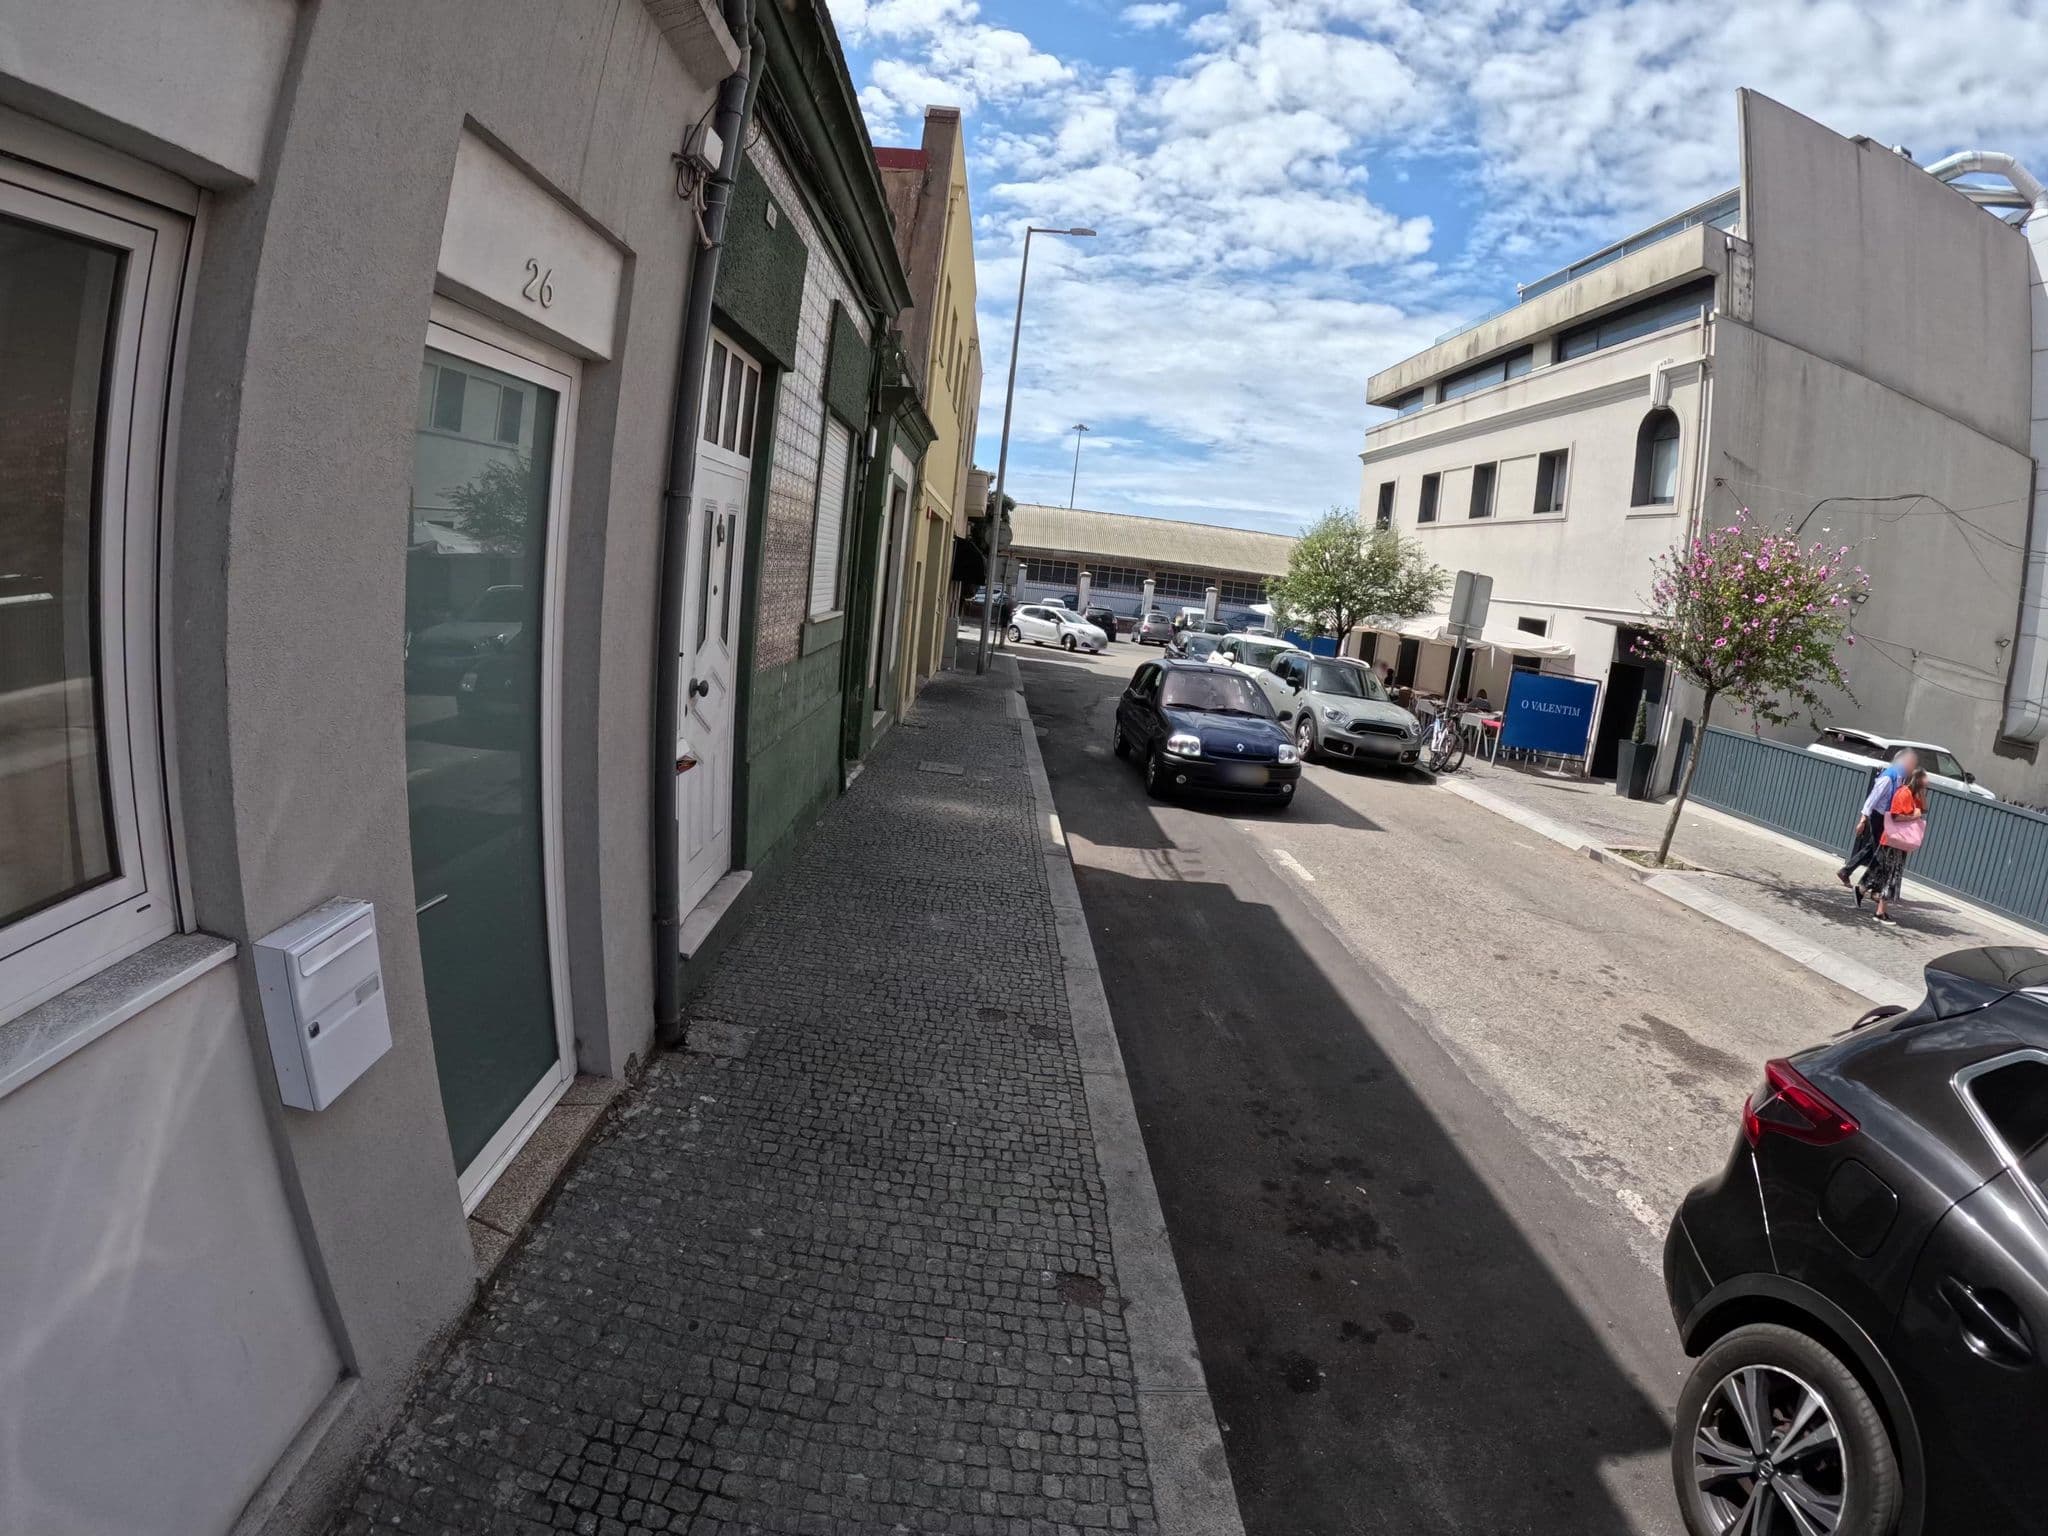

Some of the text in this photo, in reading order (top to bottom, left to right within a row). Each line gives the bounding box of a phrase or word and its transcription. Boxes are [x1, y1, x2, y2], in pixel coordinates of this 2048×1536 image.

[522, 257, 553, 309] 26
[1521, 700, 1580, 717] O VALENTIM
